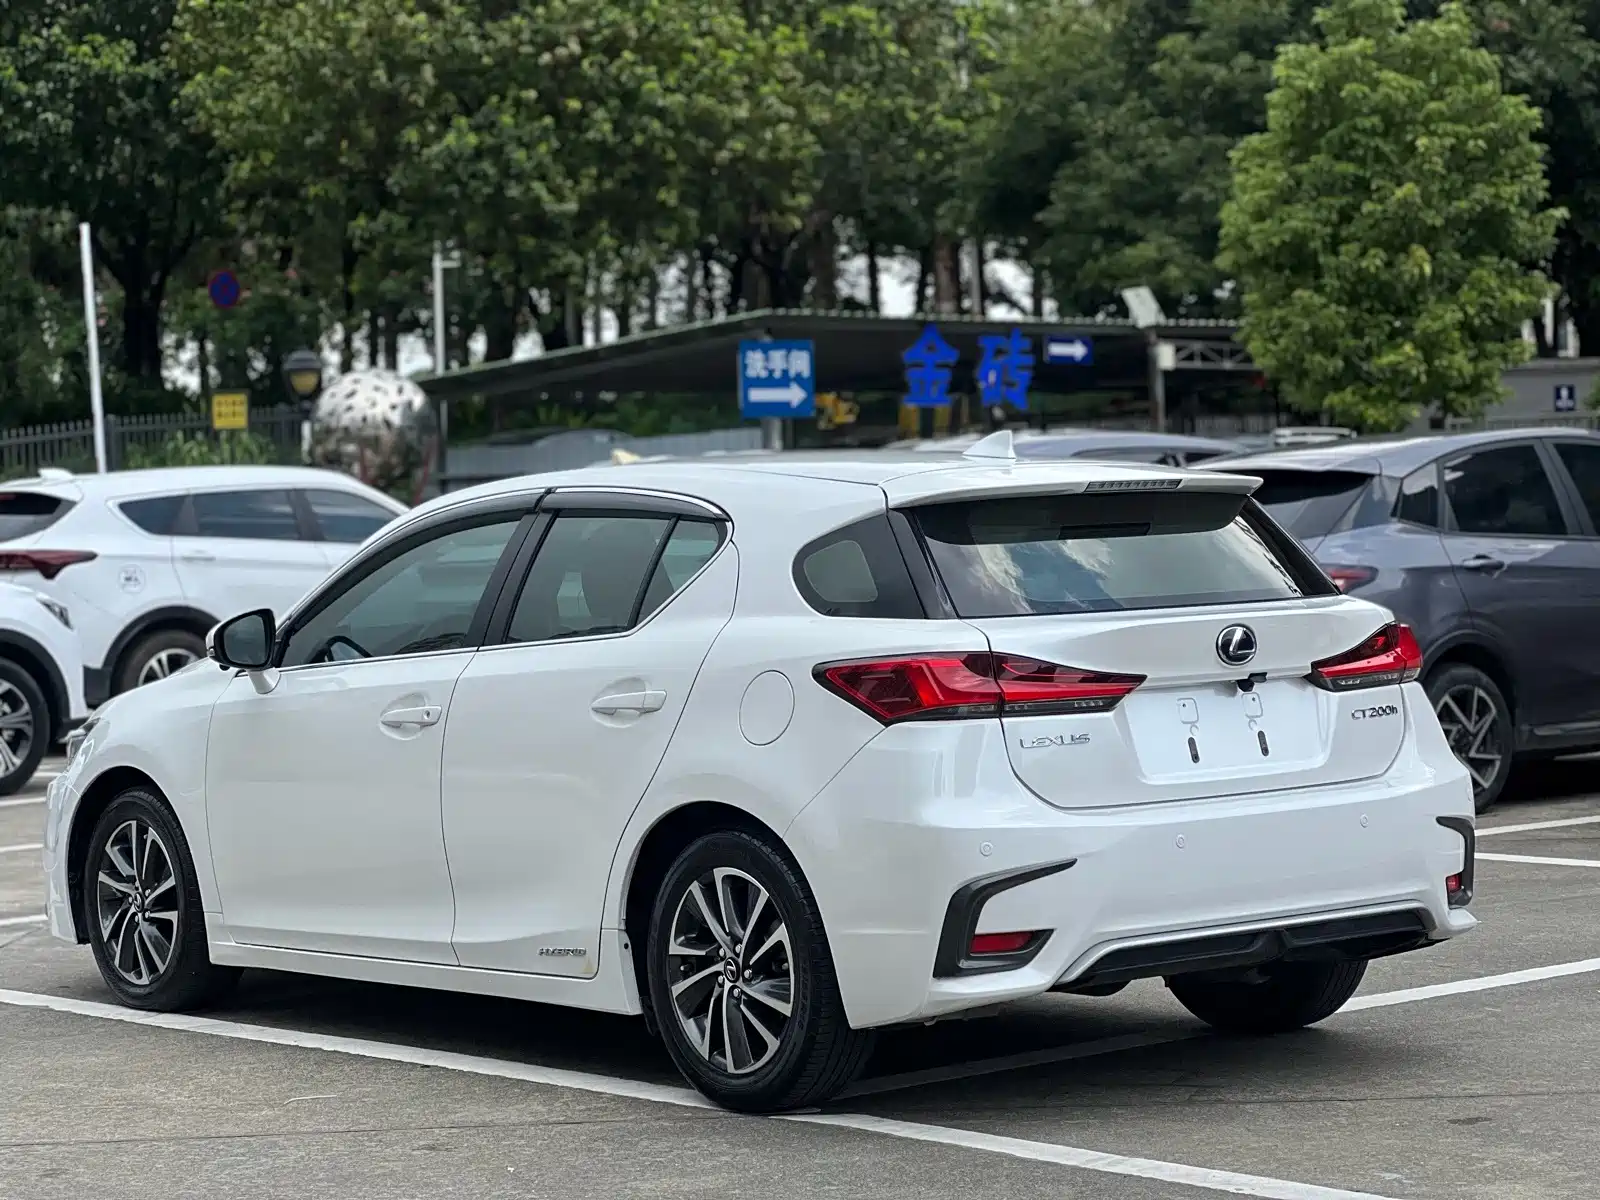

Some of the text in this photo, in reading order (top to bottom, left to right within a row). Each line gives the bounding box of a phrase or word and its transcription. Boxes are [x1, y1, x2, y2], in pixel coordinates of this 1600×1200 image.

[903, 322, 1035, 410] 金砖
[1020, 733, 1091, 749] LEXUS
[538, 947, 587, 956] HYBRID
